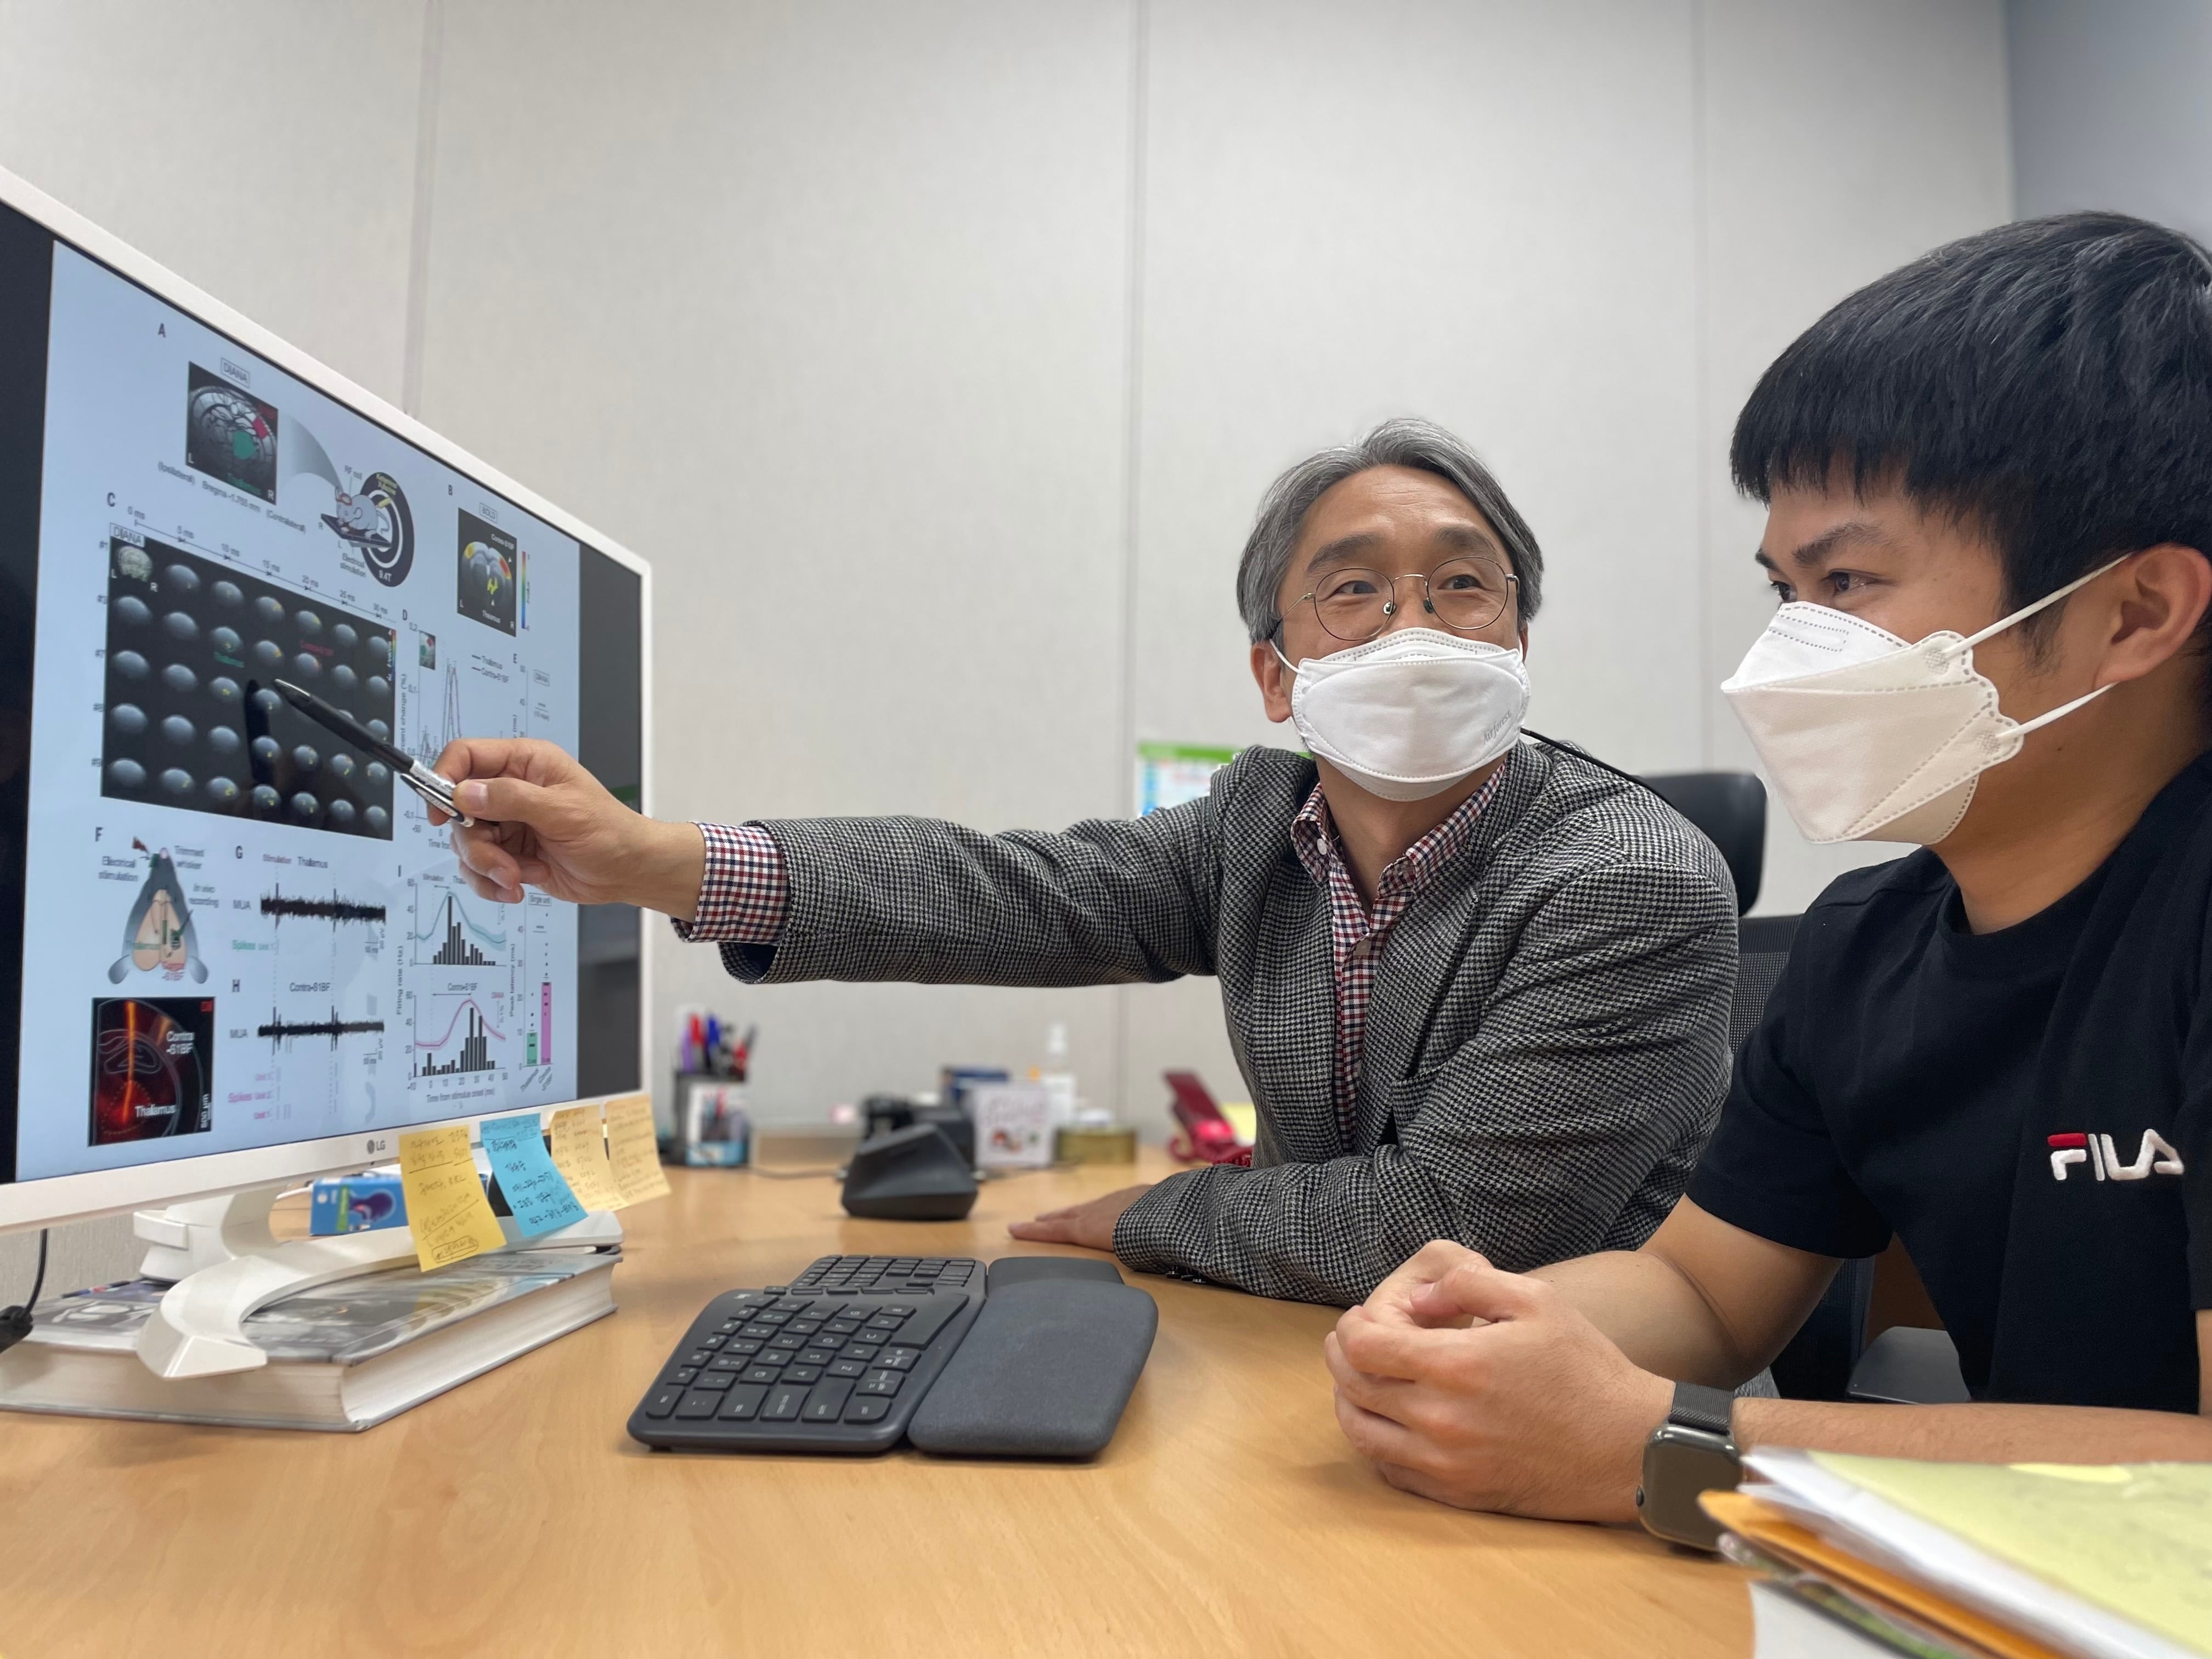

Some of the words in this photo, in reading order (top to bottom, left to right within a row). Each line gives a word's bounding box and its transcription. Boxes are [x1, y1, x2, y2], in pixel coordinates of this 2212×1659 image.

[158, 323, 166, 337] A
[189, 453, 195, 464] L
[268, 489, 274, 500] R
[449, 485, 453, 495] B
[107, 492, 115, 507] C
[114, 526, 141, 545] DIANA
[403, 610, 408, 620] D
[95, 827, 103, 842] F
[235, 845, 243, 859] G
[297, 856, 328, 868] Thalamus
[232, 979, 240, 993] H
[166, 1031, 195, 1042] Contra
[135, 1104, 177, 1117] Thalamus
[376, 1141, 385, 1151] LG
[2047, 1128, 2185, 1181] FILA
